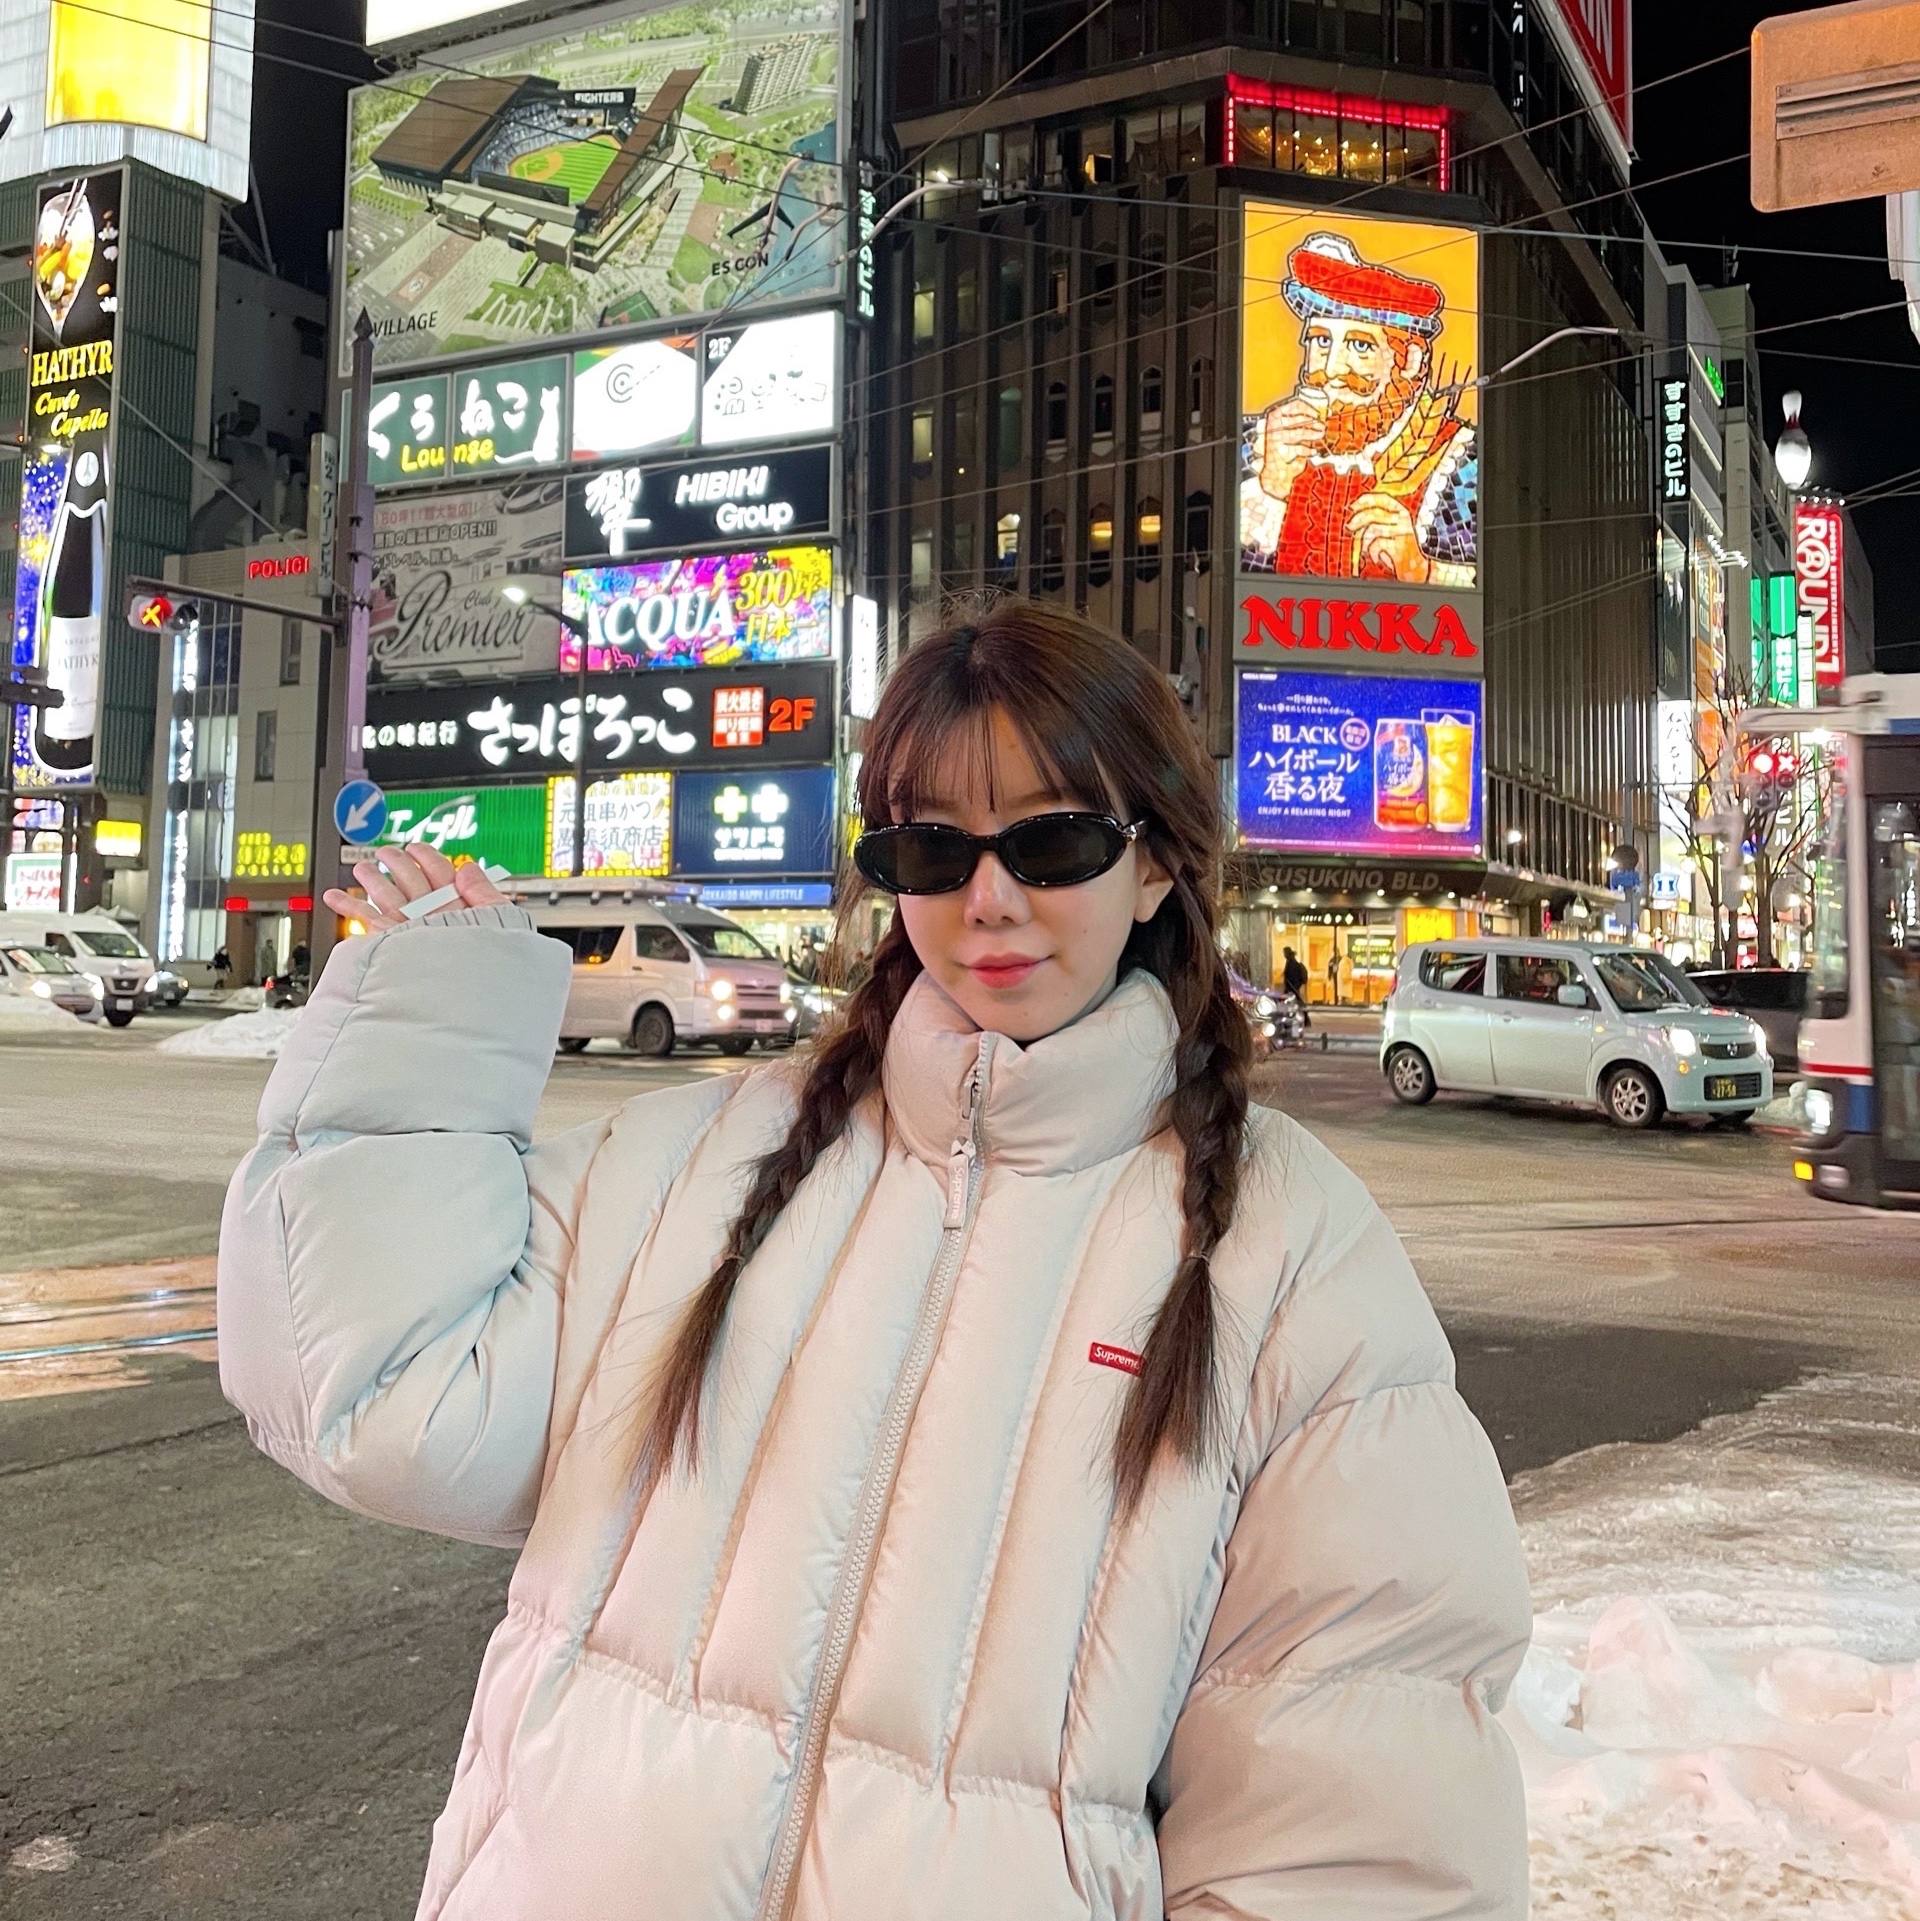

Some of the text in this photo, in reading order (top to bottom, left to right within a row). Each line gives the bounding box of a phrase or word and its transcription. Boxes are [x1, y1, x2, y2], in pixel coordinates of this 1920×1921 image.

[711, 253, 769, 276] ES CON
[373, 310, 438, 338] VILLAGE
[31, 340, 114, 387] HATHYR
[708, 336, 732, 359] 2F
[50, 407, 109, 438] Capella
[368, 378, 529, 461] くろねこ
[400, 438, 495, 473] Lounge
[674, 466, 769, 504] HIBIKI
[715, 502, 794, 532] Group
[374, 570, 535, 656] Premier
[1241, 595, 1479, 656] NIKKA
[467, 686, 697, 766] さっぽろっこ
[768, 698, 816, 732] 2F
[1272, 724, 1338, 745] BLACK
[1248, 747, 1361, 774] ハイボール
[1264, 771, 1346, 804] 香る夜
[1257, 806, 1351, 818] ENJOY A RELAXING NIGHT
[1260, 868, 1444, 891] SUSUKINO BLD.
[950, 1166, 965, 1220] Supreme
